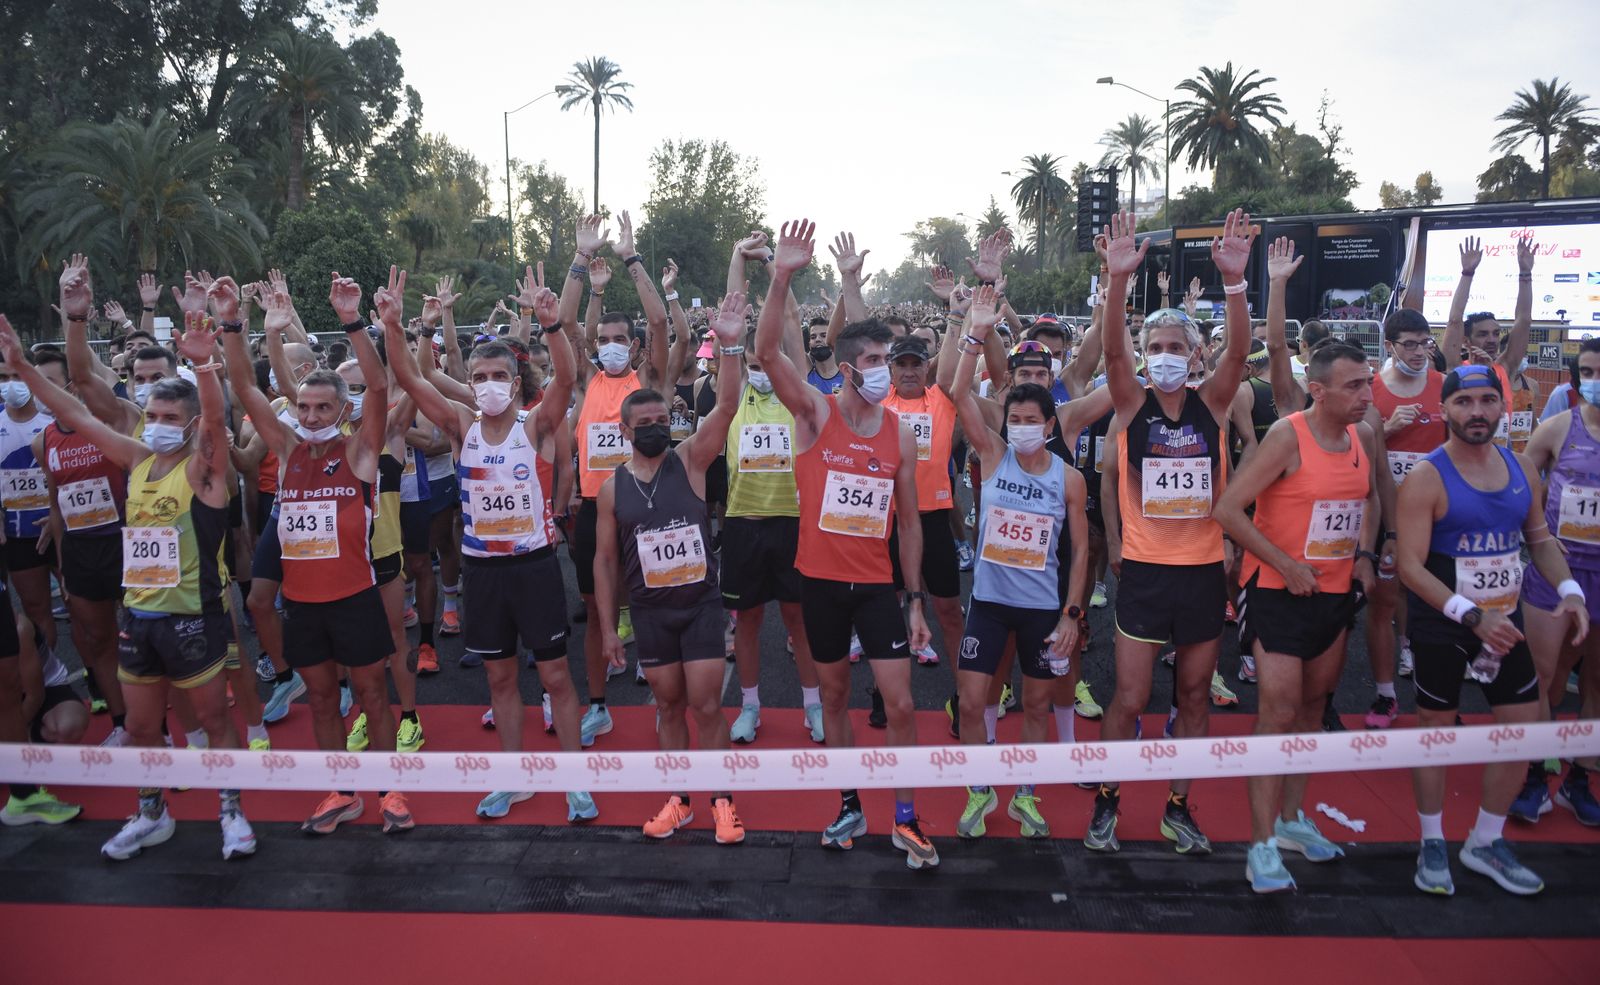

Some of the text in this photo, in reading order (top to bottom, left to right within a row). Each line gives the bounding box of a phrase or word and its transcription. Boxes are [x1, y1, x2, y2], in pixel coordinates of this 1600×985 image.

[597, 433, 624, 448] 221
[753, 434, 770, 449] 91
[9, 478, 38, 491] 128
[995, 477, 1044, 501] nerja
[1155, 472, 1195, 490] 413
[67, 490, 94, 508] 167
[280, 486, 357, 500] AN PEDRO
[837, 487, 874, 508] 354
[999, 494, 1036, 508] ATLETISMO
[481, 495, 515, 512] 346
[286, 515, 317, 532] 343
[1324, 513, 1351, 531] 121
[997, 521, 1034, 542] 455
[132, 541, 160, 559] 280
[652, 541, 687, 561] 104
[1473, 569, 1510, 590] 328
